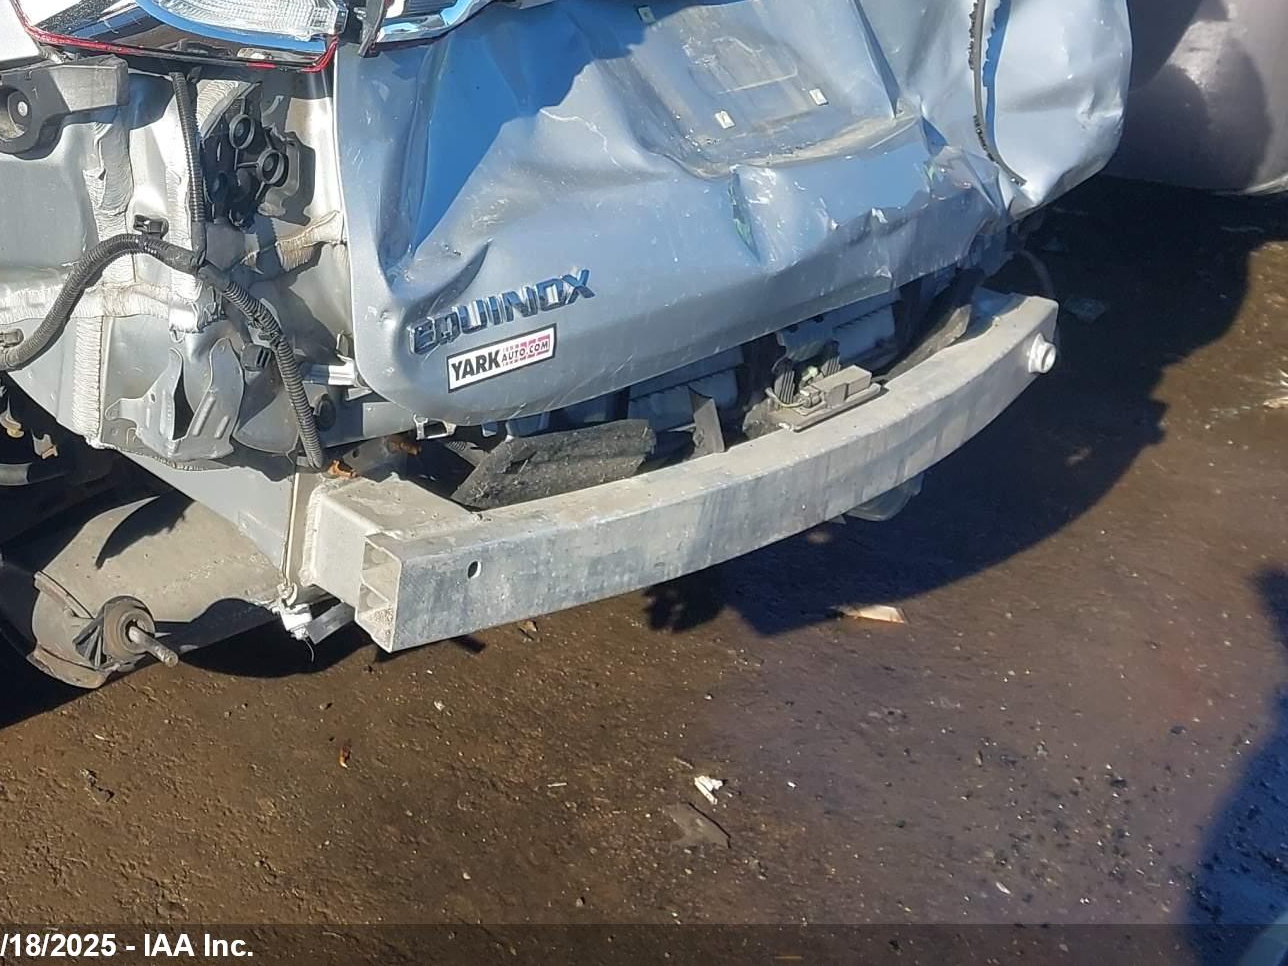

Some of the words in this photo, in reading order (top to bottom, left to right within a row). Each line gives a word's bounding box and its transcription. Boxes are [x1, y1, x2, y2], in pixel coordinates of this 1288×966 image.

[408, 268, 596, 354] EQUINOX
[450, 349, 502, 382] YARK
[501, 340, 548, 363] AUTO.COM
